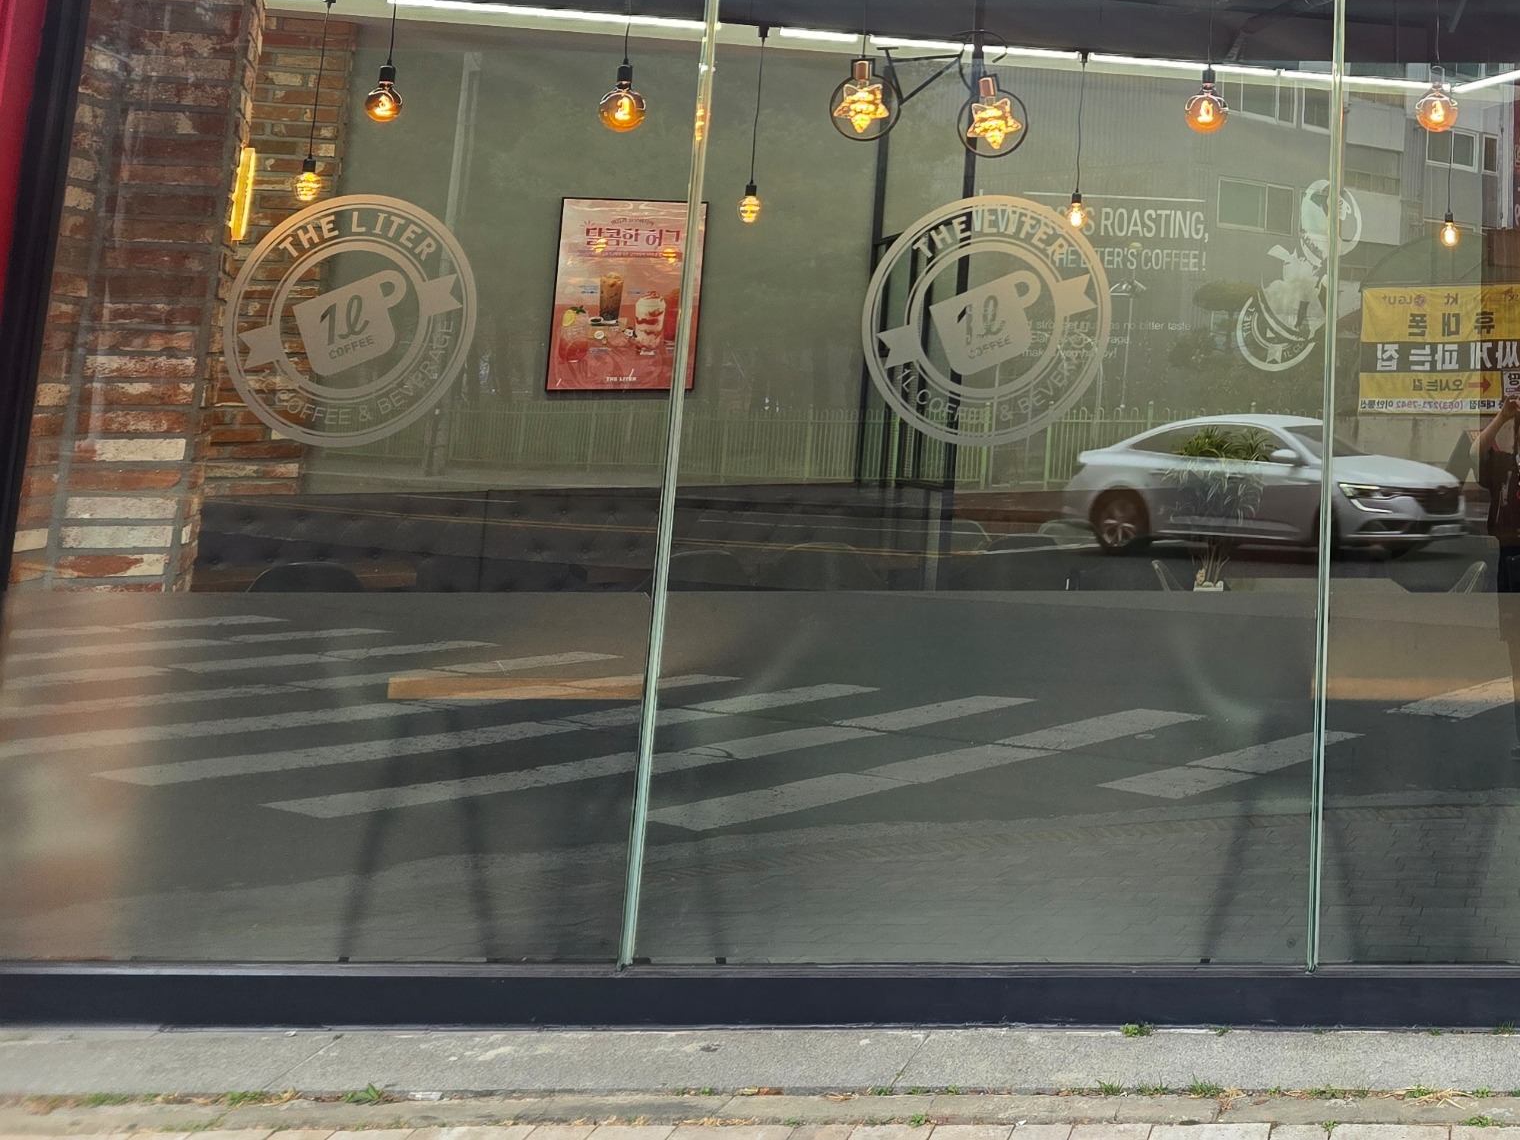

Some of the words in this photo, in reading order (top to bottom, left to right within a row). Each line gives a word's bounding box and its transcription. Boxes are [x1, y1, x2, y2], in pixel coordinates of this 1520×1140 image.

[279, 214, 340, 259] THE
[350, 211, 438, 262] LITER
[912, 216, 973, 260] THE
[1101, 210, 1209, 242] ROASTING,
[328, 334, 376, 360] COFFEE
